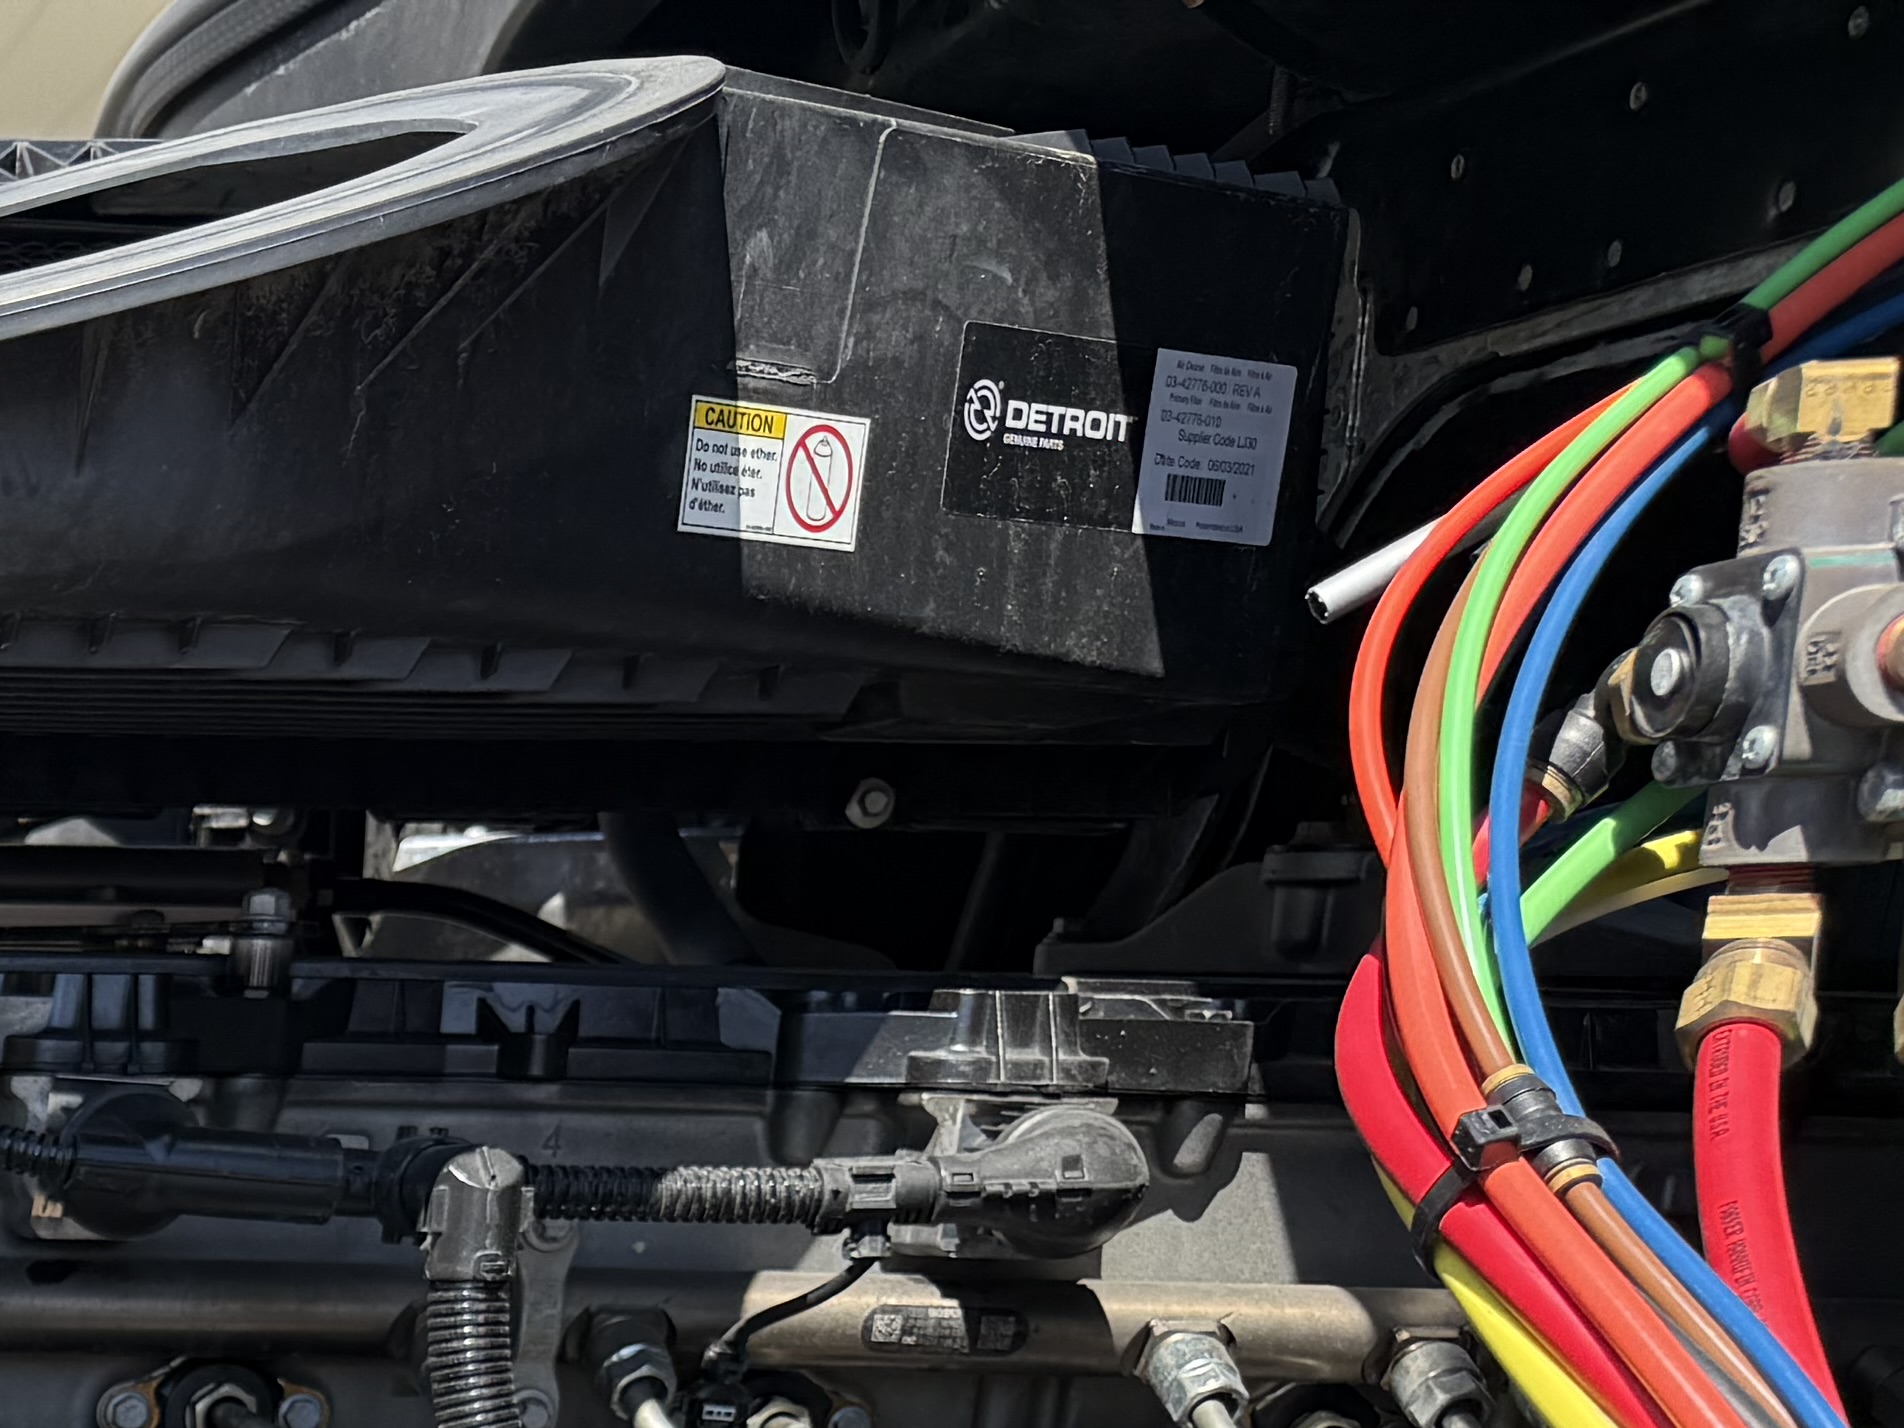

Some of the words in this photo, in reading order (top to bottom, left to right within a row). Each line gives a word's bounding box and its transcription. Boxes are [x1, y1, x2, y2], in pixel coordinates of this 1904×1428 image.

[705, 407, 774, 434] CAUTION
[1005, 400, 1131, 442] DETROIT
[696, 438, 709, 452] Do
[712, 443, 728, 456] not
[694, 458, 707, 471] No
